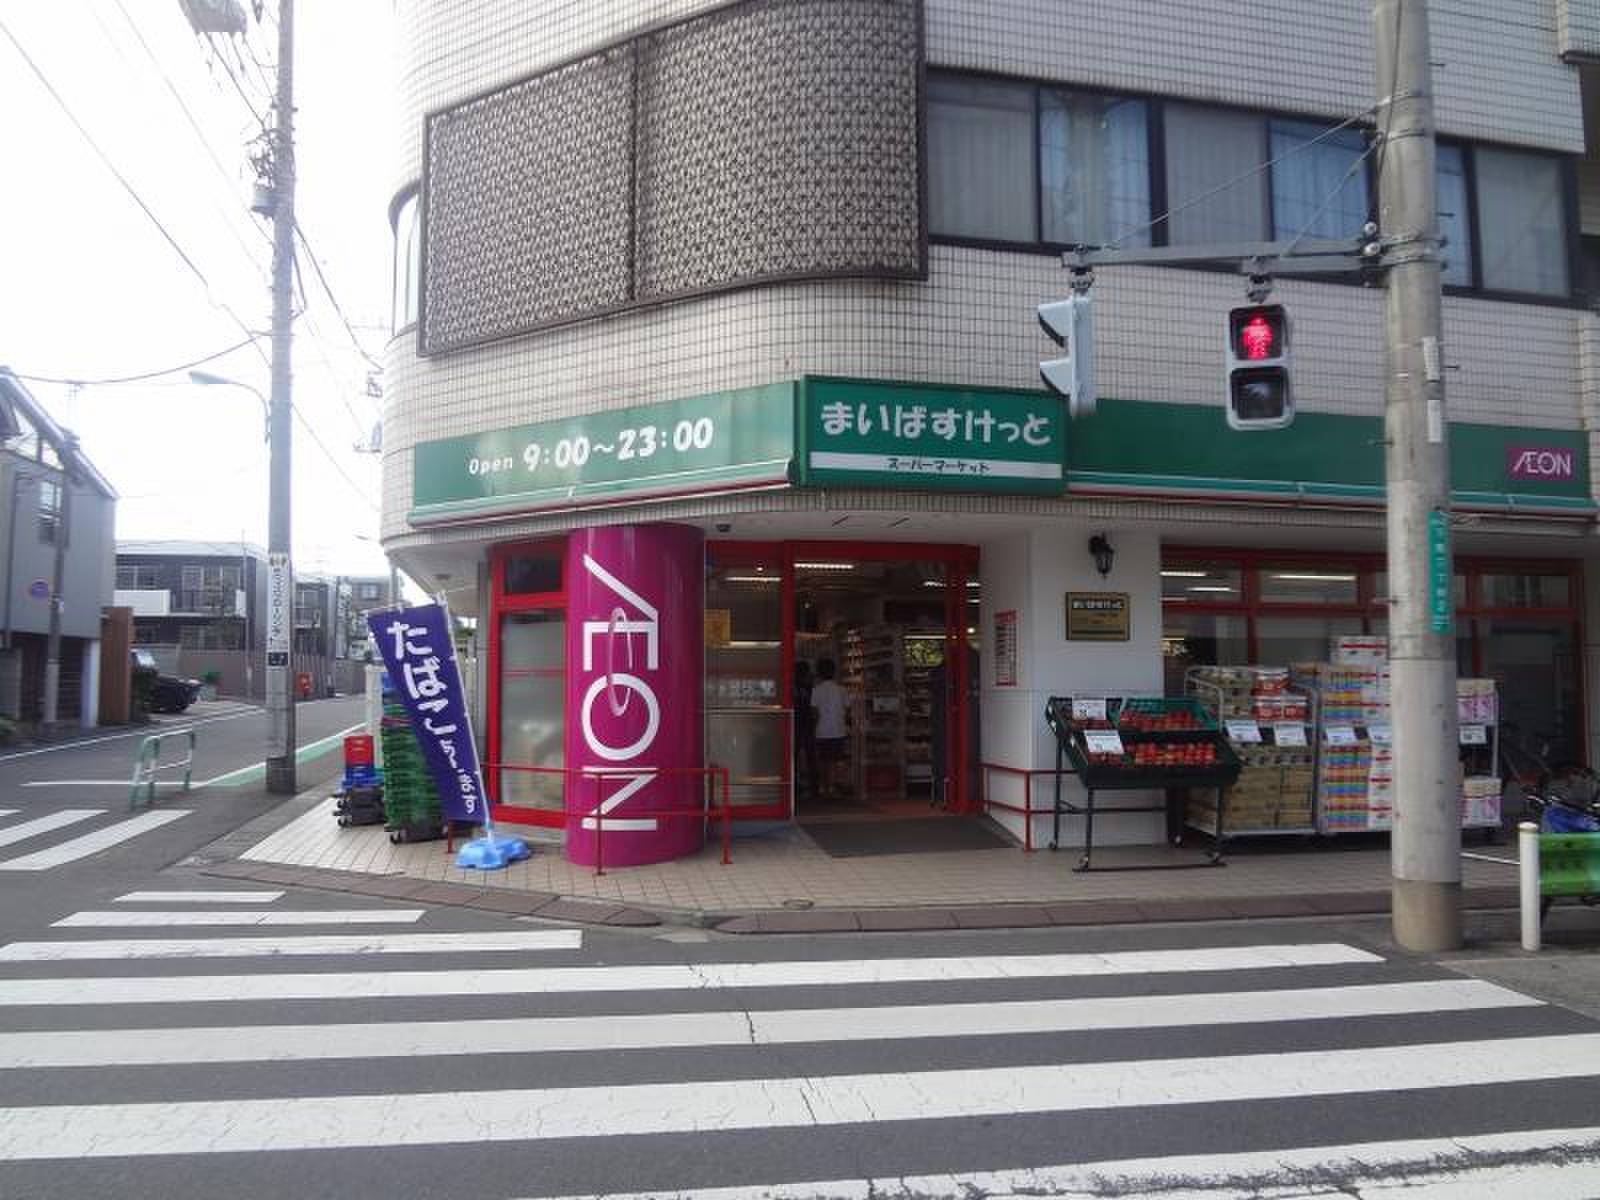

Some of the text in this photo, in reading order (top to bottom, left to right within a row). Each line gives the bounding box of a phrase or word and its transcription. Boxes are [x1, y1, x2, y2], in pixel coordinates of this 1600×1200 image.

[821, 401, 1051, 446] まいばすけっと
[468, 456, 513, 475] Open
[886, 457, 991, 475] スーパーマーケット
